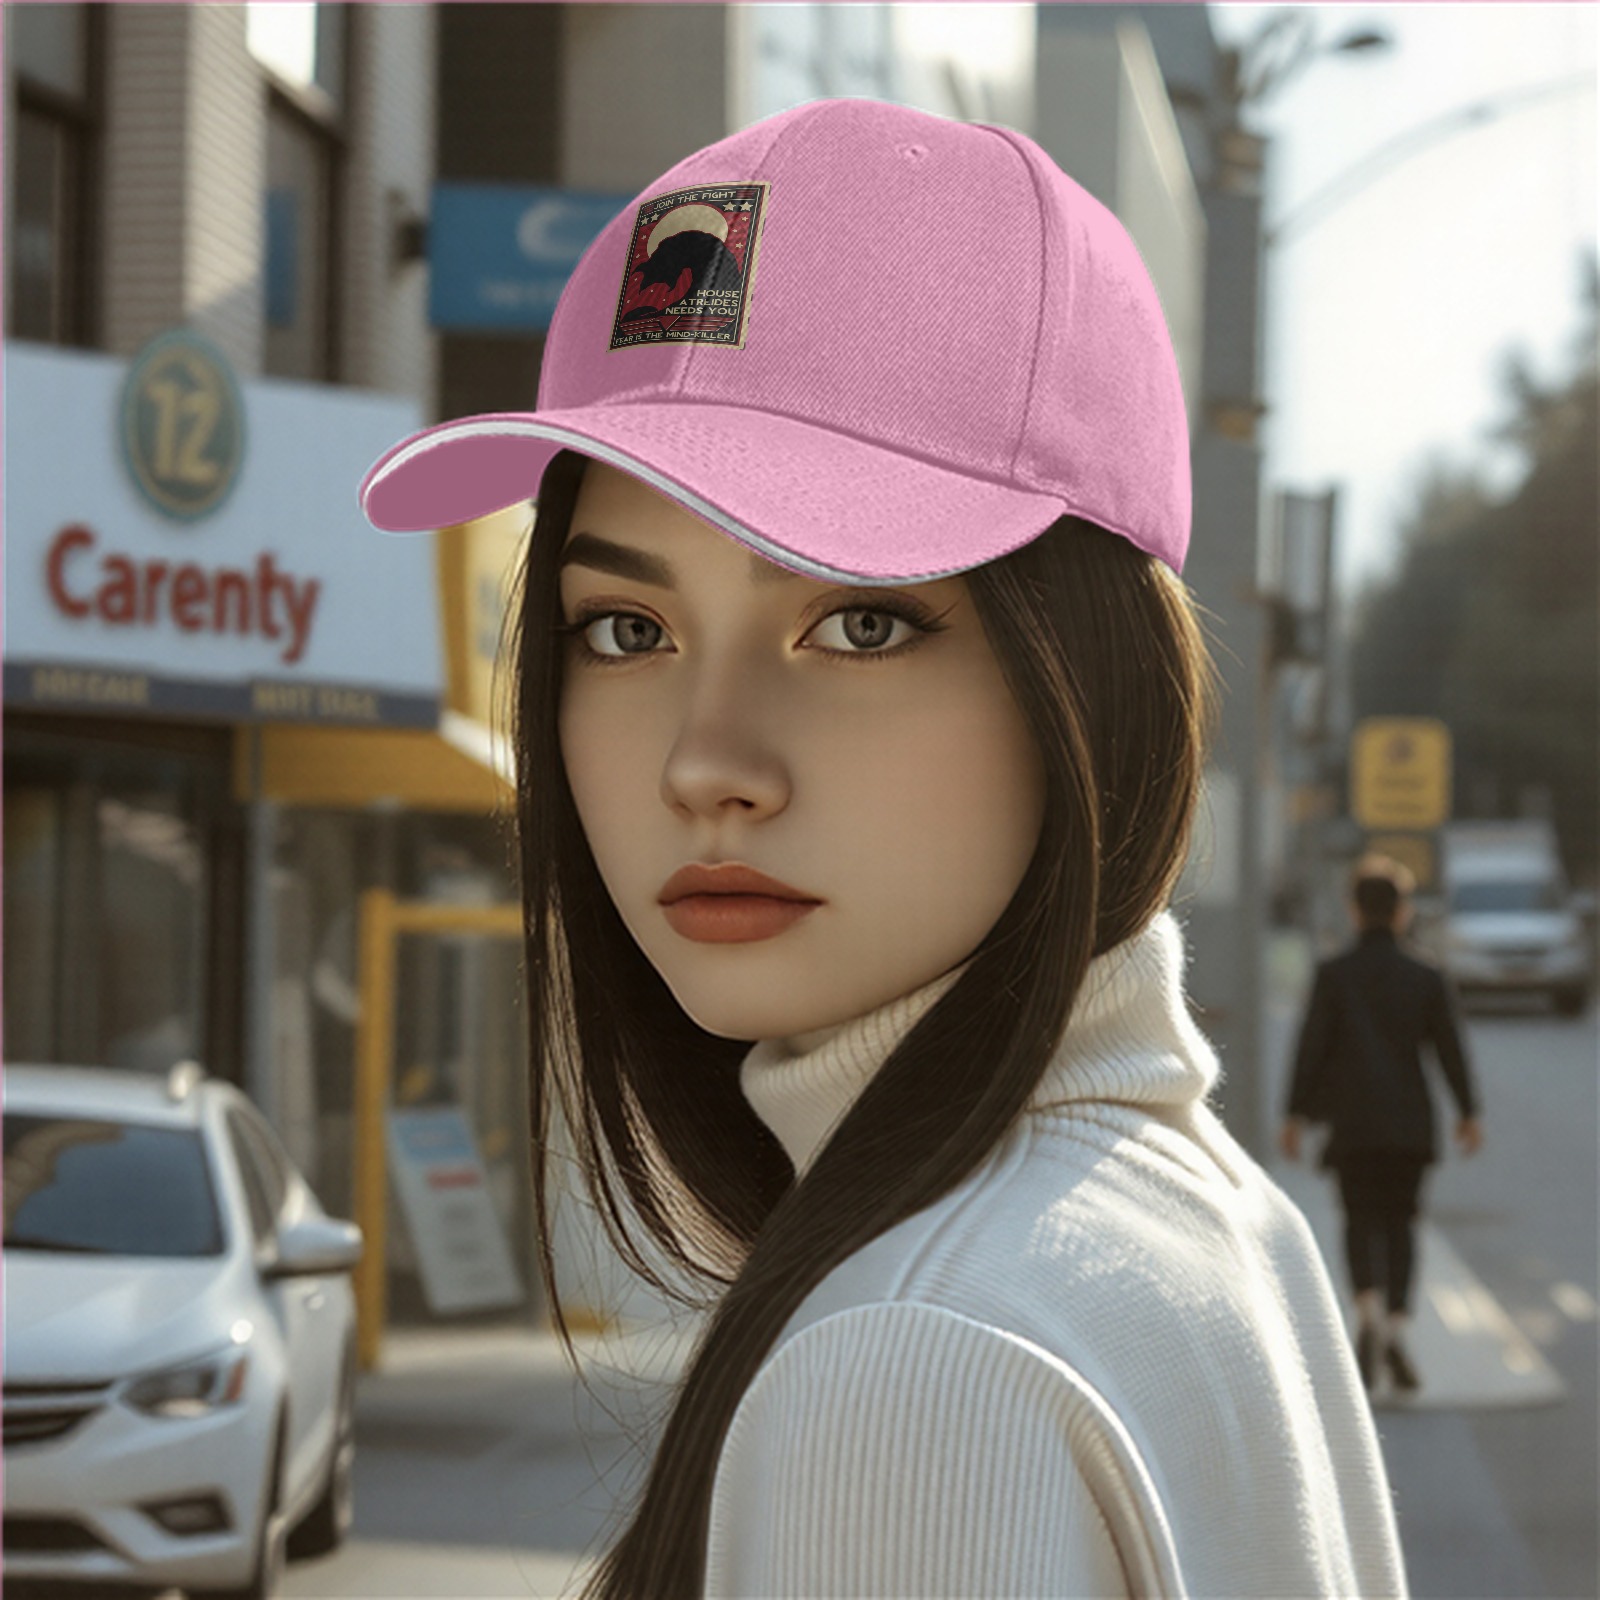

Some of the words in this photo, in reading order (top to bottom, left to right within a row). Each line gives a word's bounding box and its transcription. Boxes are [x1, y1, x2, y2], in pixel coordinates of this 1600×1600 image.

[653, 198, 674, 210] JOIN
[678, 193, 698, 204] THE
[701, 190, 736, 200] FIGHT
[696, 289, 740, 298] HOUSE
[679, 298, 739, 307] ATREIDES
[665, 306, 703, 315] NEEDS
[708, 307, 737, 316] YOU
[615, 335, 634, 344] FEAR
[635, 333, 642, 341] IS
[666, 331, 731, 340] MIND-KILLER
[45, 522, 321, 666] Carenty
